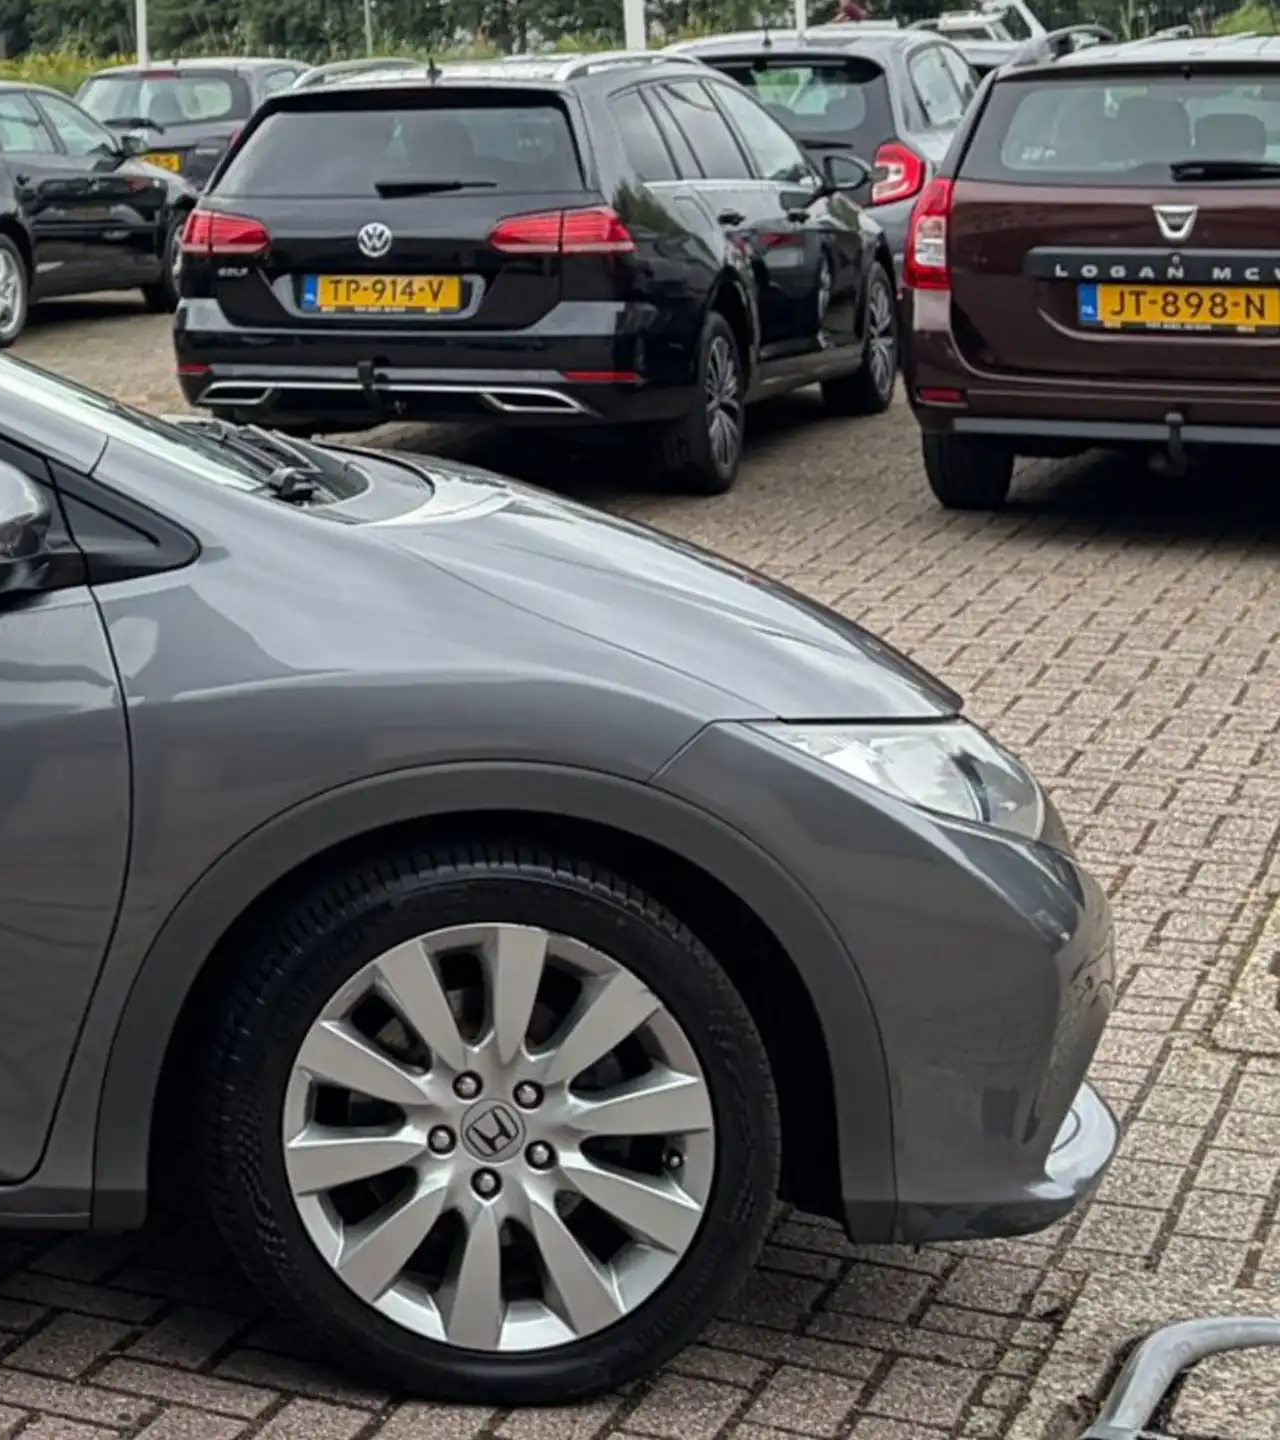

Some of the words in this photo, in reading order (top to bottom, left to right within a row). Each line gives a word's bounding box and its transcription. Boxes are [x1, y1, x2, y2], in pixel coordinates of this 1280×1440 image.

[1054, 263, 1185, 279] LOGAN
[329, 278, 445, 303] TP-914-V
[1110, 289, 1266, 320] JT-898-N
